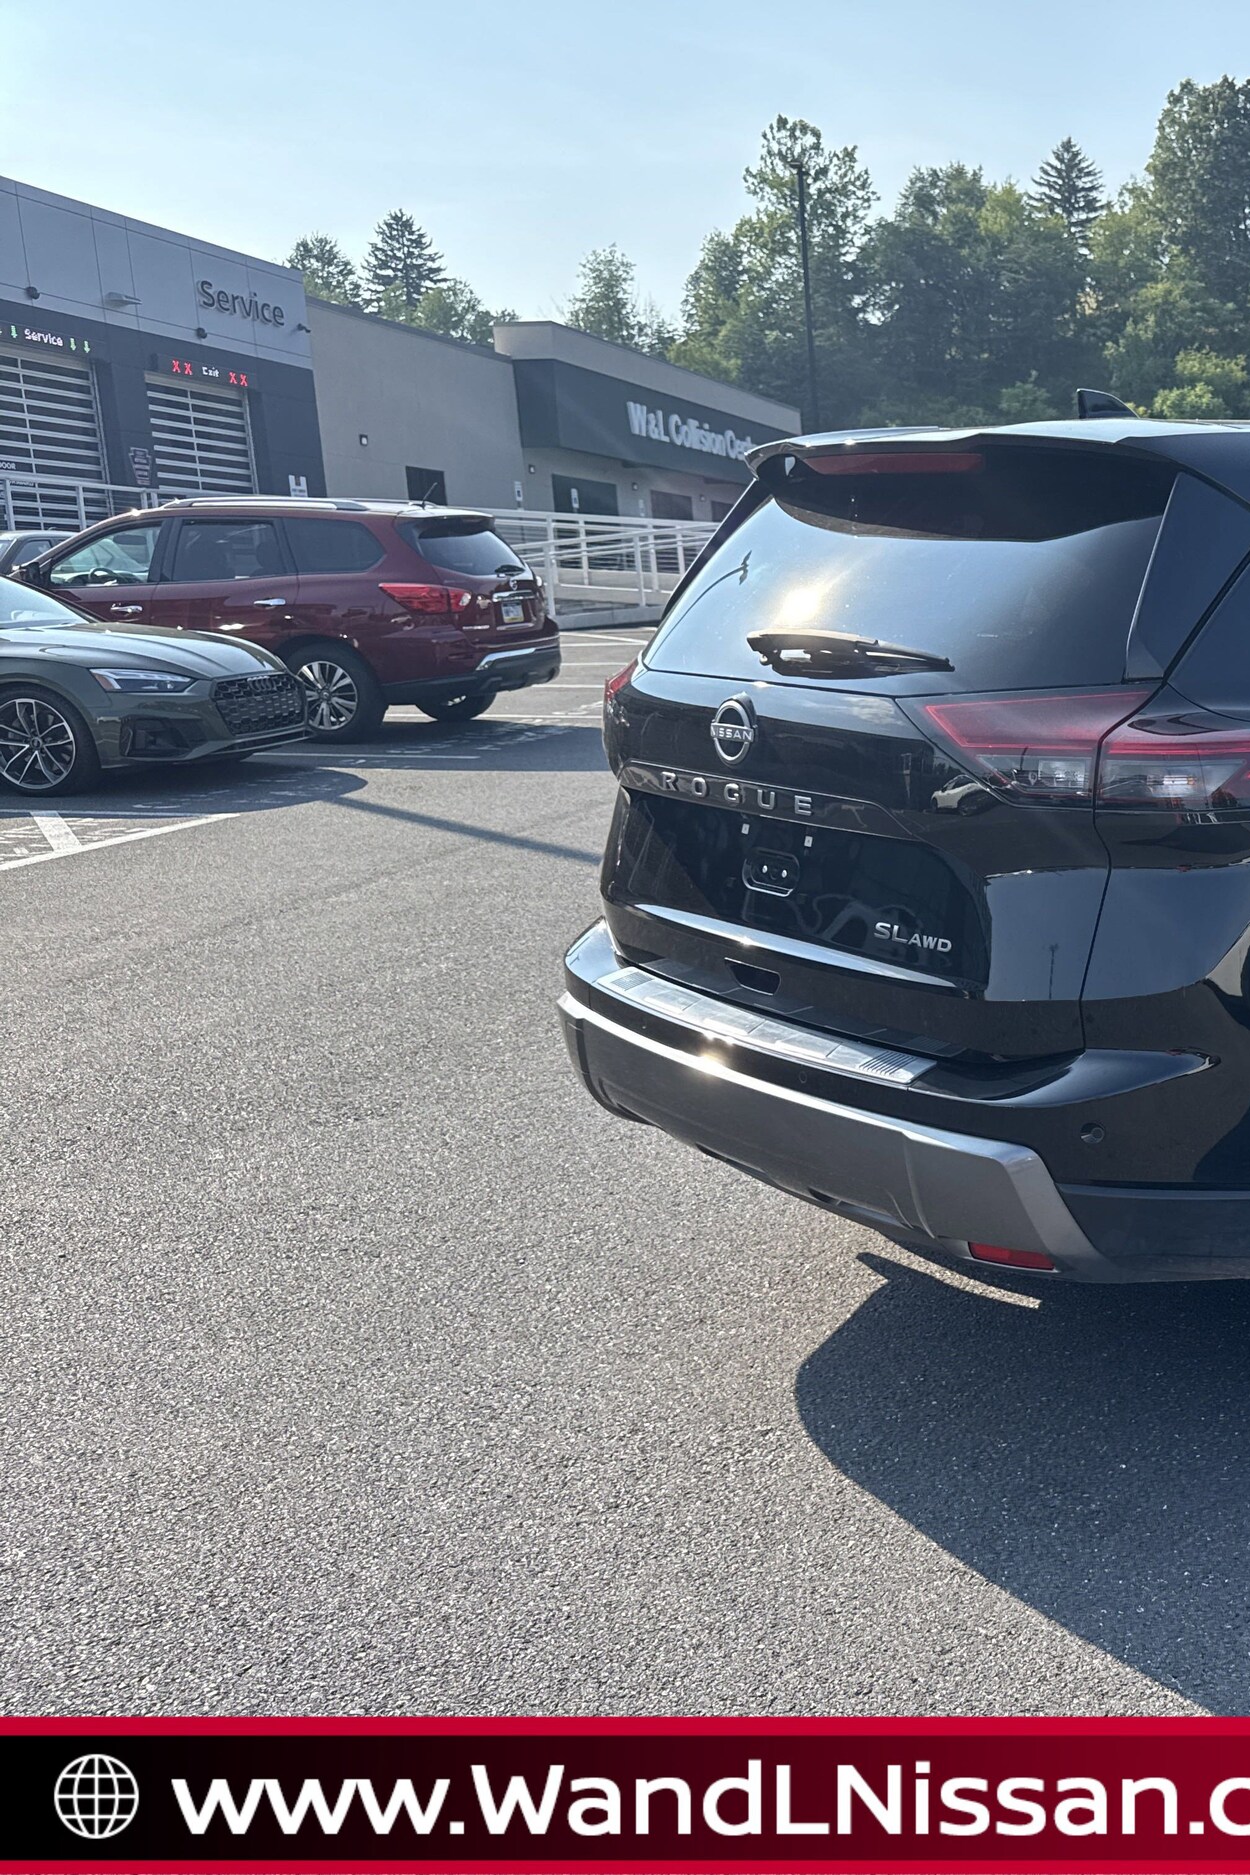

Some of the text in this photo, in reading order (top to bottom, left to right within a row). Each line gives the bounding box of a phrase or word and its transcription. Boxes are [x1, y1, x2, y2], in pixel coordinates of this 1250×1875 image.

[199, 280, 286, 327] Service
[24, 329, 63, 347] Service
[626, 401, 670, 443] W&L
[668, 414, 727, 456] Collision
[711, 724, 752, 741] NISSAN
[660, 771, 812, 816] ROGUE
